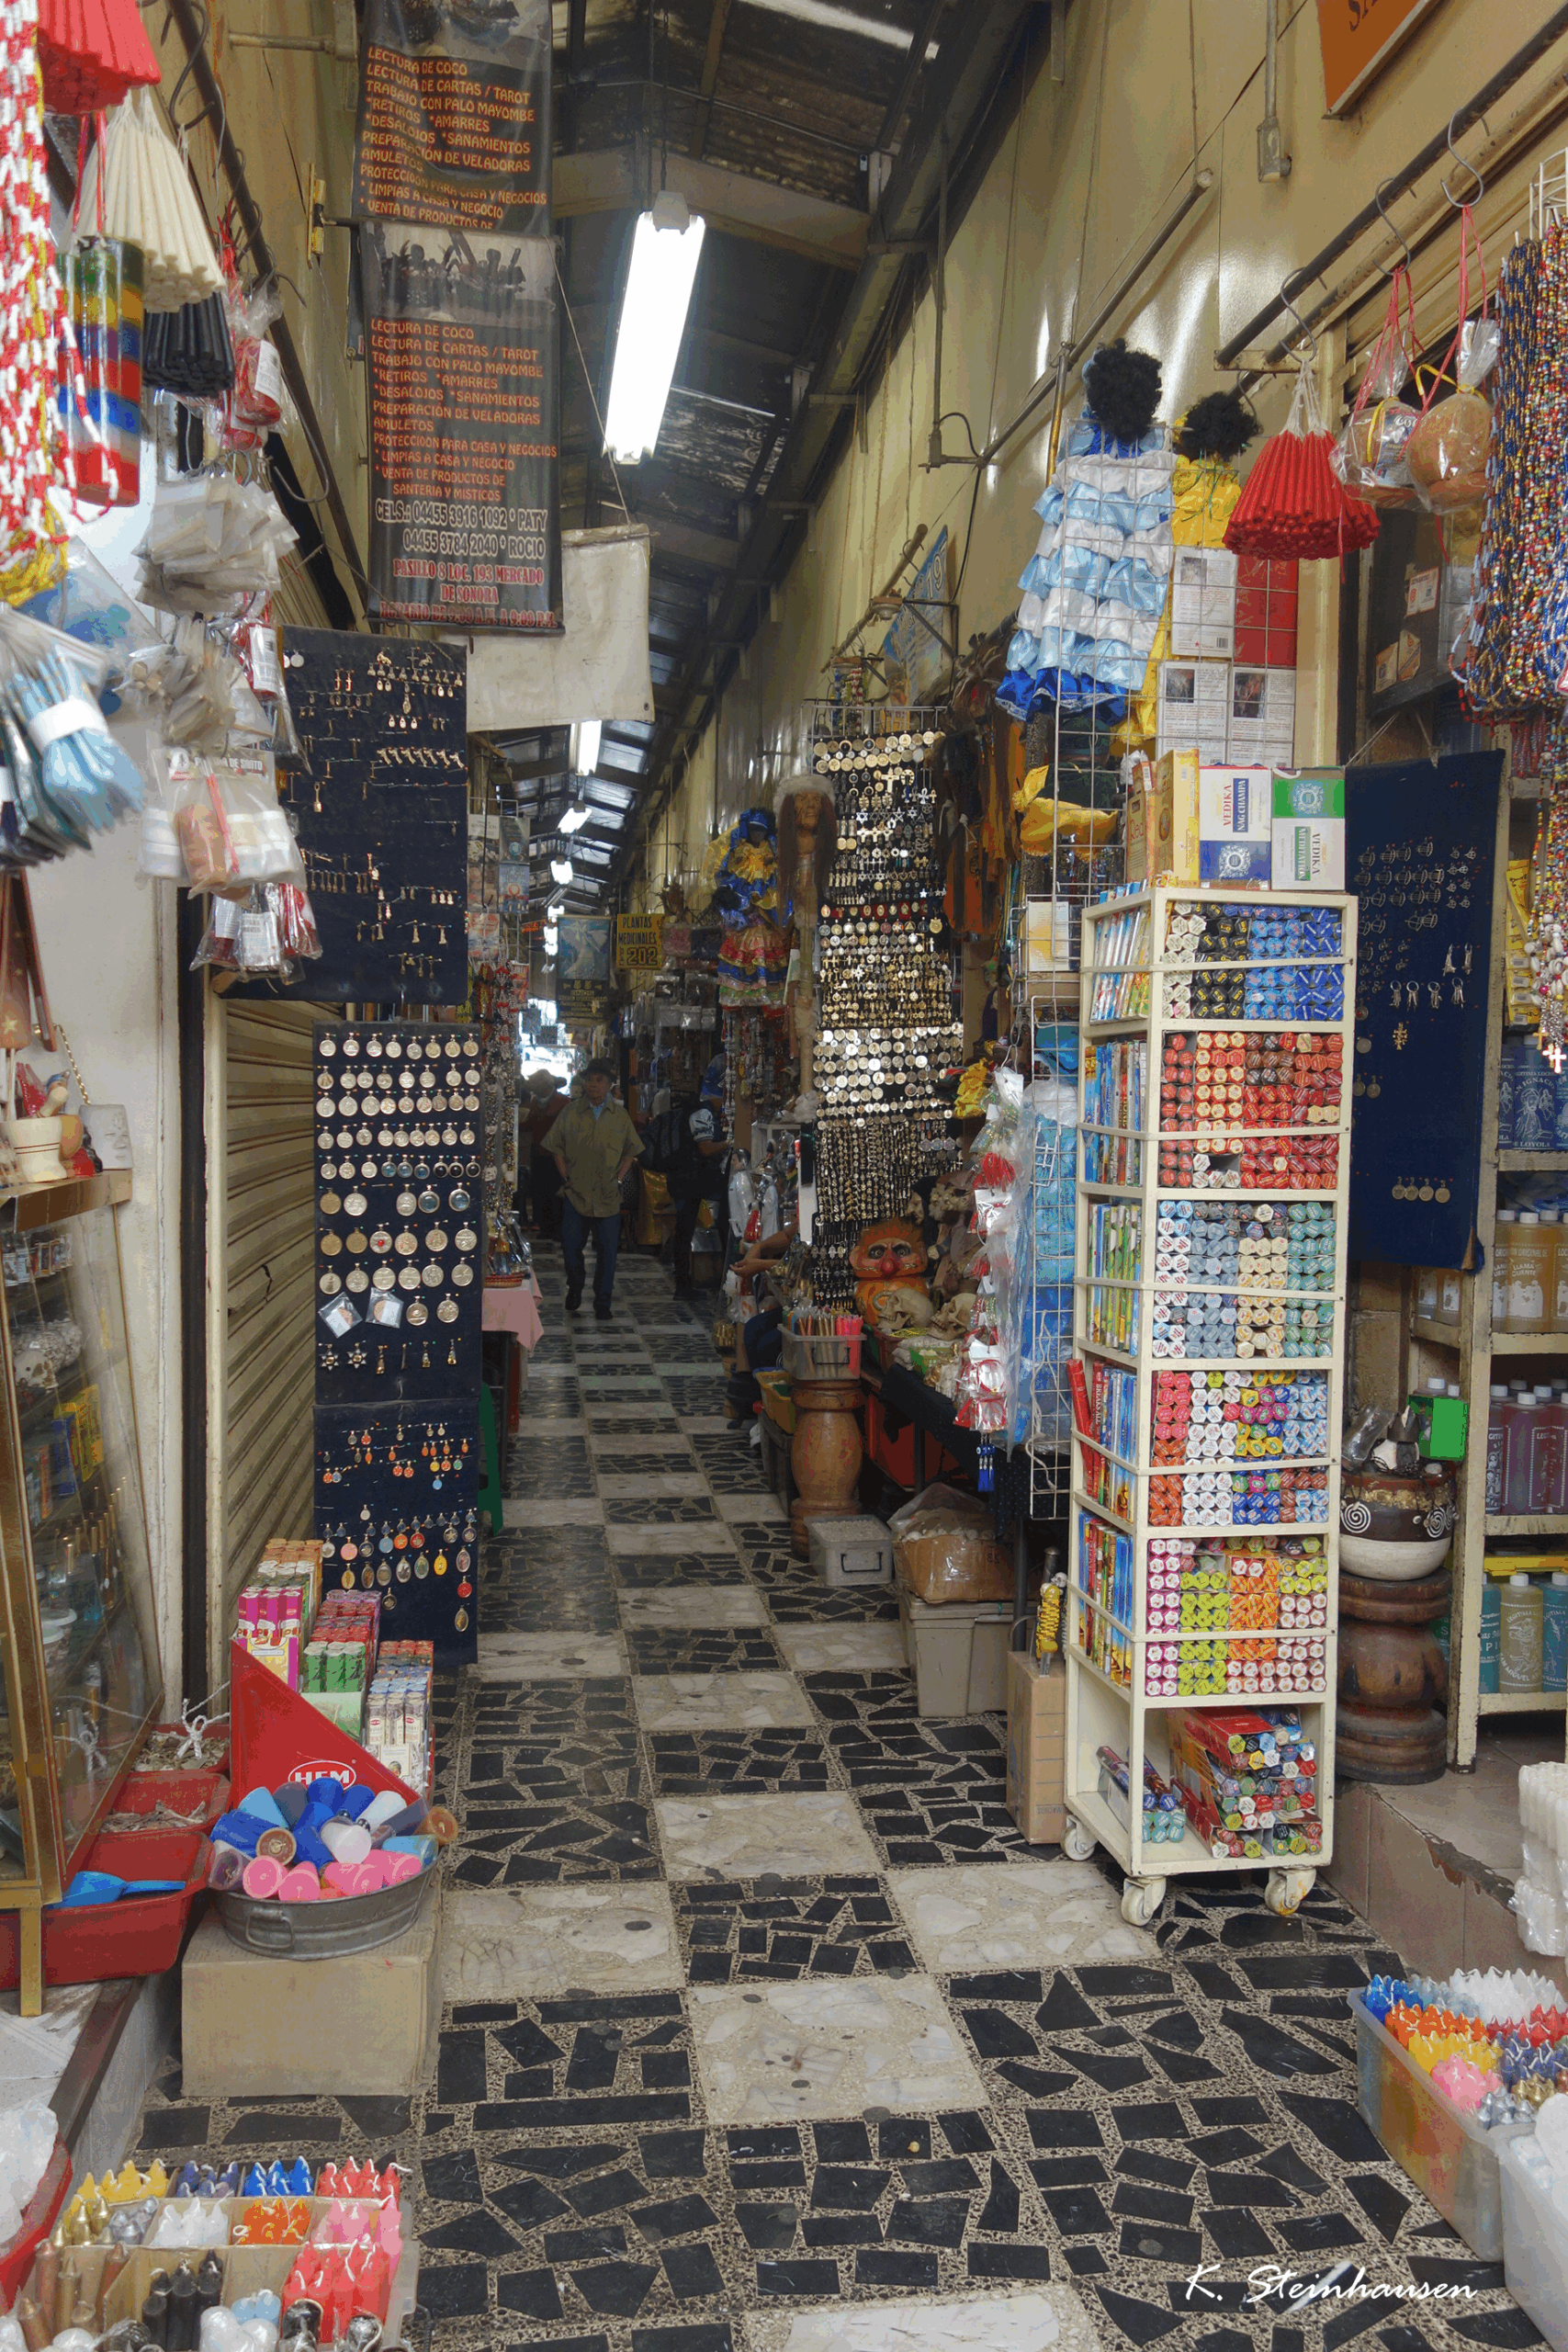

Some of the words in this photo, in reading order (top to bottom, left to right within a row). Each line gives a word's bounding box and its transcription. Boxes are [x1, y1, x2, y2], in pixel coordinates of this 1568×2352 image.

[368, 47, 419, 74] LECTURA
[422, 62, 434, 74] DE
[436, 62, 468, 76] COCO
[367, 63, 418, 90] LECTURA
[422, 79, 434, 92] DE
[436, 80, 481, 96] CARTAS
[493, 86, 530, 105] TAROT
[367, 80, 417, 107] TRABAJO
[421, 95, 442, 110] CON
[445, 98, 474, 112] PALO
[478, 103, 534, 122] MAYOMBE
[361, 147, 423, 172] AMULETOS
[445, 151, 459, 164] DE
[463, 152, 530, 172] VELADORAS
[368, 183, 410, 199] LIMPIAS
[412, 190, 420, 201] A
[423, 192, 450, 208] CASA
[453, 198, 458, 209] Y
[461, 200, 503, 219] NEGOCIO
[432, 179, 457, 197] PARA
[460, 187, 486, 199] CASA
[490, 190, 496, 200] Y
[498, 190, 547, 205] NEGOCIOS
[367, 199, 400, 215] VENTA
[403, 204, 415, 218] DE
[419, 208, 479, 229] PRODUCTOS
[371, 318, 421, 335] LECTURA
[424, 322, 439, 337] DE
[442, 324, 474, 340] COCO
[371, 335, 421, 351] LECTURA
[424, 339, 440, 353] DE
[443, 341, 488, 356] CARTAS
[502, 346, 537, 361] TAROT
[371, 351, 422, 368] TRABAJO
[426, 356, 449, 370] CON
[453, 358, 481, 372] PALO
[485, 362, 543, 378] MAYOMBE
[373, 417, 434, 432] AMULETOS
[455, 405, 469, 420] DE
[472, 407, 540, 425] VELADORAS
[381, 450, 421, 464] LIMPIAS
[423, 452, 431, 465] A
[434, 454, 460, 467] CASA
[463, 456, 468, 468] Y
[471, 457, 514, 470] NEGOCIO
[442, 437, 468, 451] PARA
[471, 440, 497, 454] CASA
[500, 442, 506, 455] Y
[508, 444, 558, 458] NEGOCIOS
[382, 467, 413, 480] VENTA
[416, 469, 428, 481] DE
[432, 470, 490, 485] PRODUCTOS
[492, 473, 505, 486] DE
[393, 483, 442, 497] SANTERIA
[445, 486, 450, 498] Y
[454, 487, 501, 501] MISTICOS
[412, 502, 447, 526] 04455
[449, 505, 478, 527] 3916
[479, 507, 506, 530] 1092
[518, 509, 548, 531] PATY
[402, 528, 438, 552] 04455
[440, 531, 467, 554] 3784
[469, 534, 498, 557] 2040
[508, 537, 546, 560] ROCIO
[393, 559, 436, 579] PASILLO
[437, 560, 446, 579] 8
[447, 561, 471, 582] LOC.
[473, 563, 492, 582] 193
[495, 565, 545, 585] MERCADO
[440, 582, 455, 603] DE
[457, 584, 499, 605] SONORA
[1223, 785, 1232, 826] VEDIKA
[1237, 780, 1246, 814] CHAMPA
[1237, 814, 1246, 831] NAG
[1298, 828, 1306, 879] MEDITATION
[1312, 832, 1321, 875] VEDIKA
[622, 915, 652, 929] PLANTAS
[618, 931, 657, 944] MEDICINALES
[626, 947, 658, 966] 202
